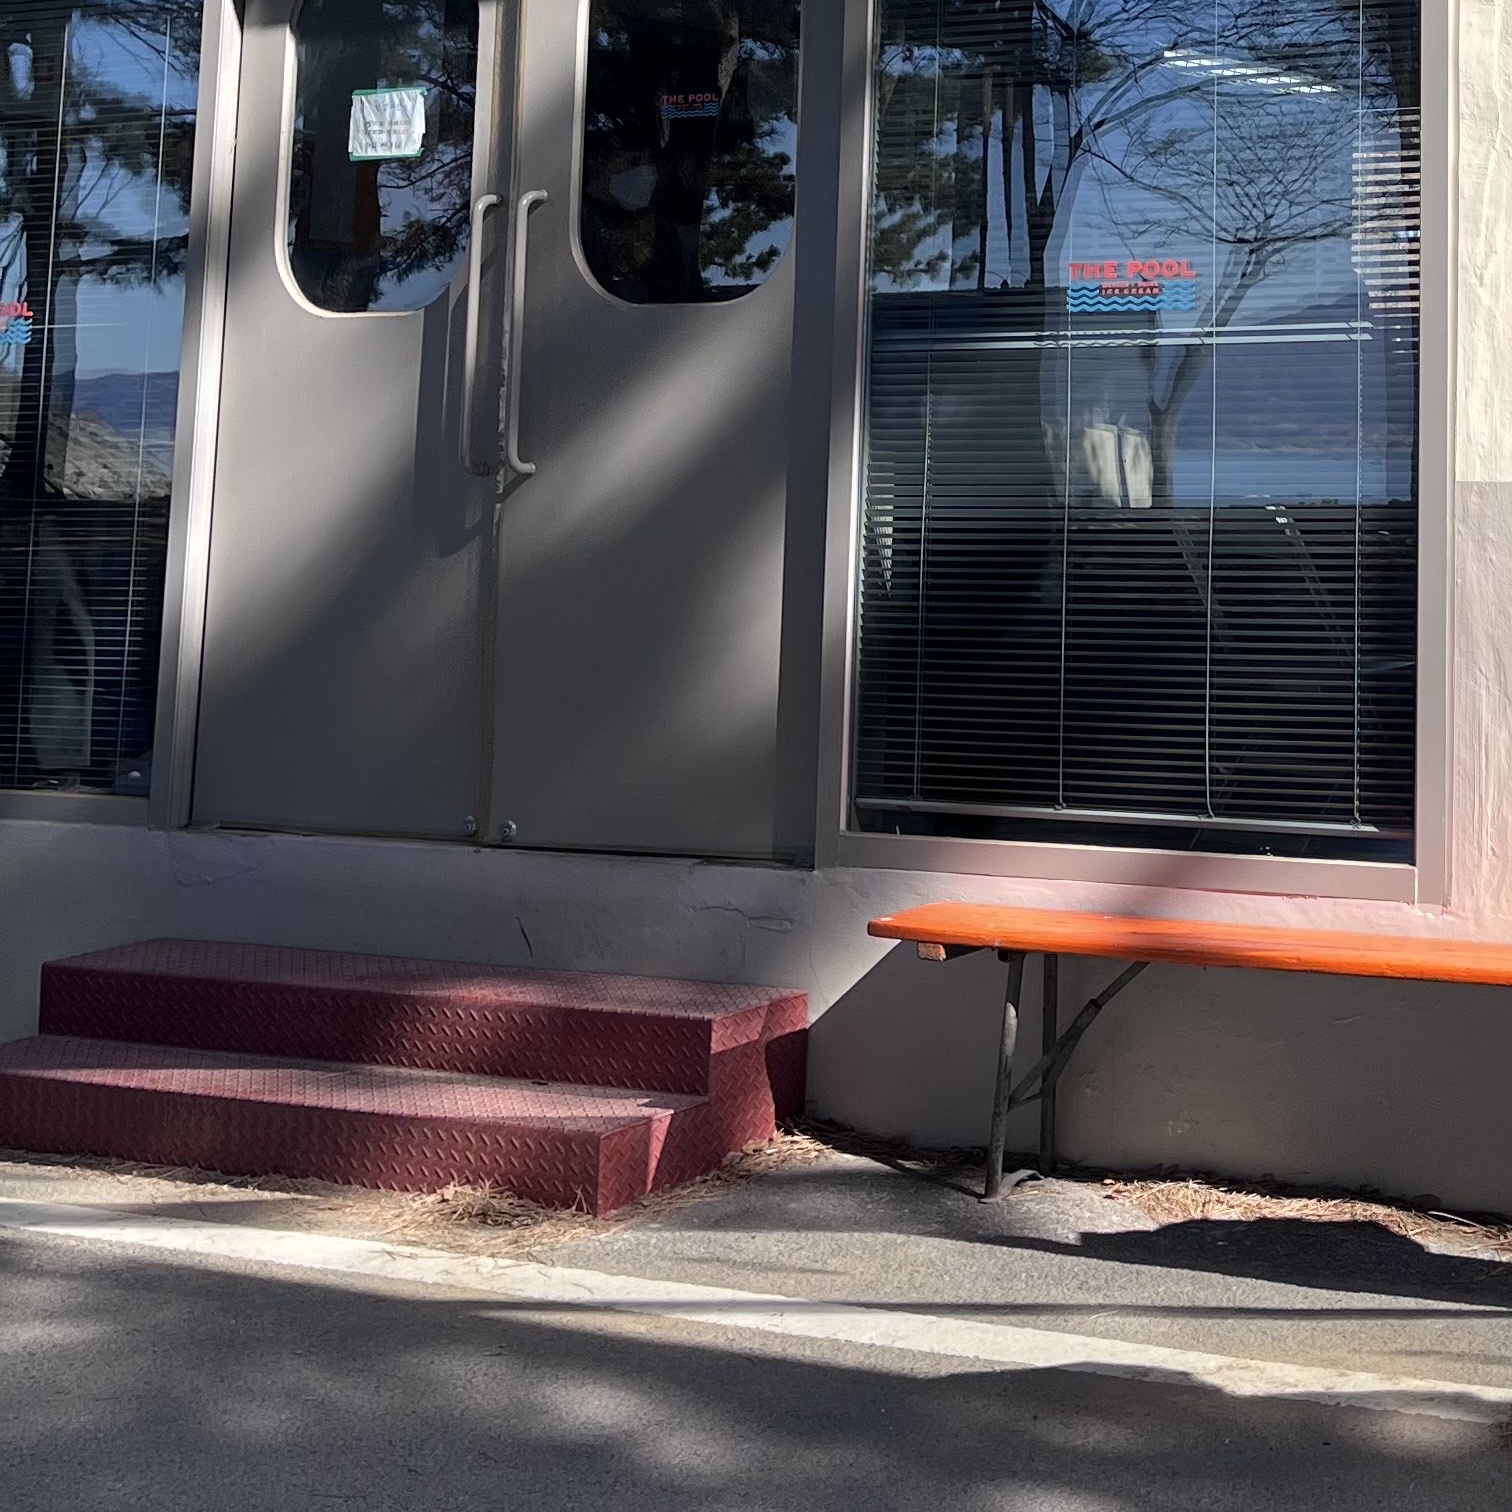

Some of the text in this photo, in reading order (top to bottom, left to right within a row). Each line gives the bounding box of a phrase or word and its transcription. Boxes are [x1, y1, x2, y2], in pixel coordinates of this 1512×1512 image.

[662, 93, 719, 104] THE POOL
[1069, 259, 1196, 279] THE POOL
[0, 302, 33, 317] OOL
